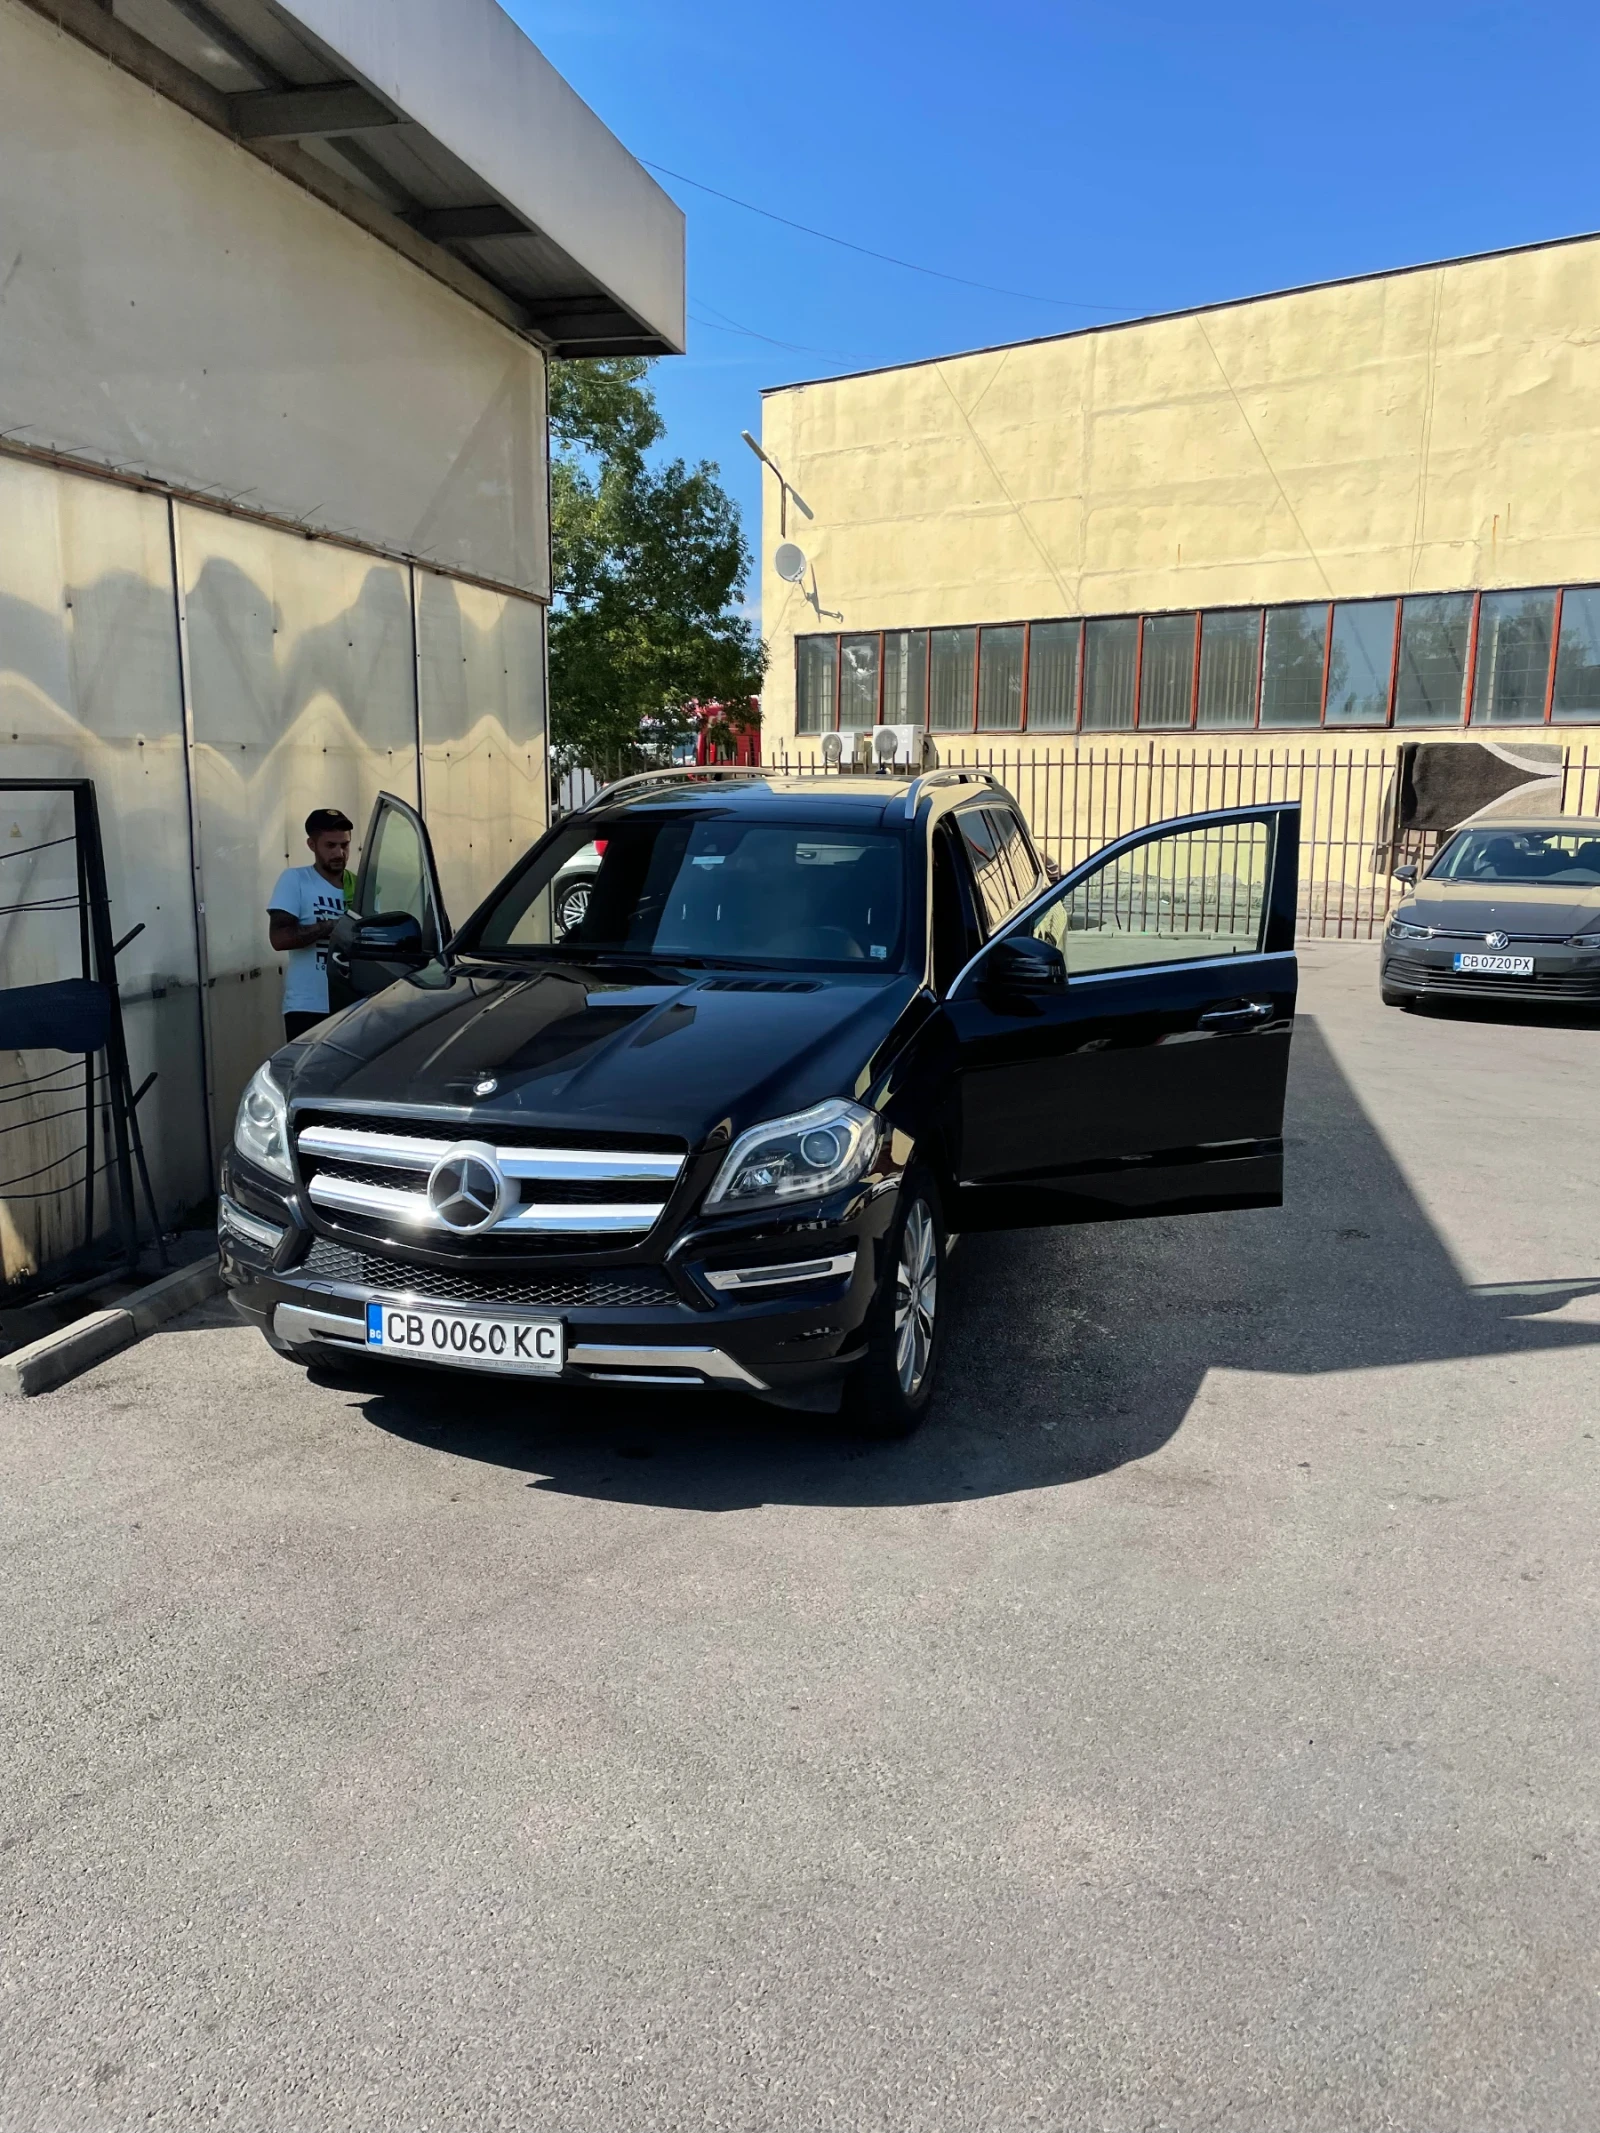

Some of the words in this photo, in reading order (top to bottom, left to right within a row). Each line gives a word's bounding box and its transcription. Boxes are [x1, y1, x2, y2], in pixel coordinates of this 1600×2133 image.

[1462, 955, 1479, 967] CB
[1481, 957, 1512, 969] 0720
[1514, 958, 1531, 970] PX
[369, 1329, 382, 1340] BG
[387, 1312, 425, 1346] CB
[431, 1318, 507, 1355] 0060
[514, 1325, 556, 1359] KC
